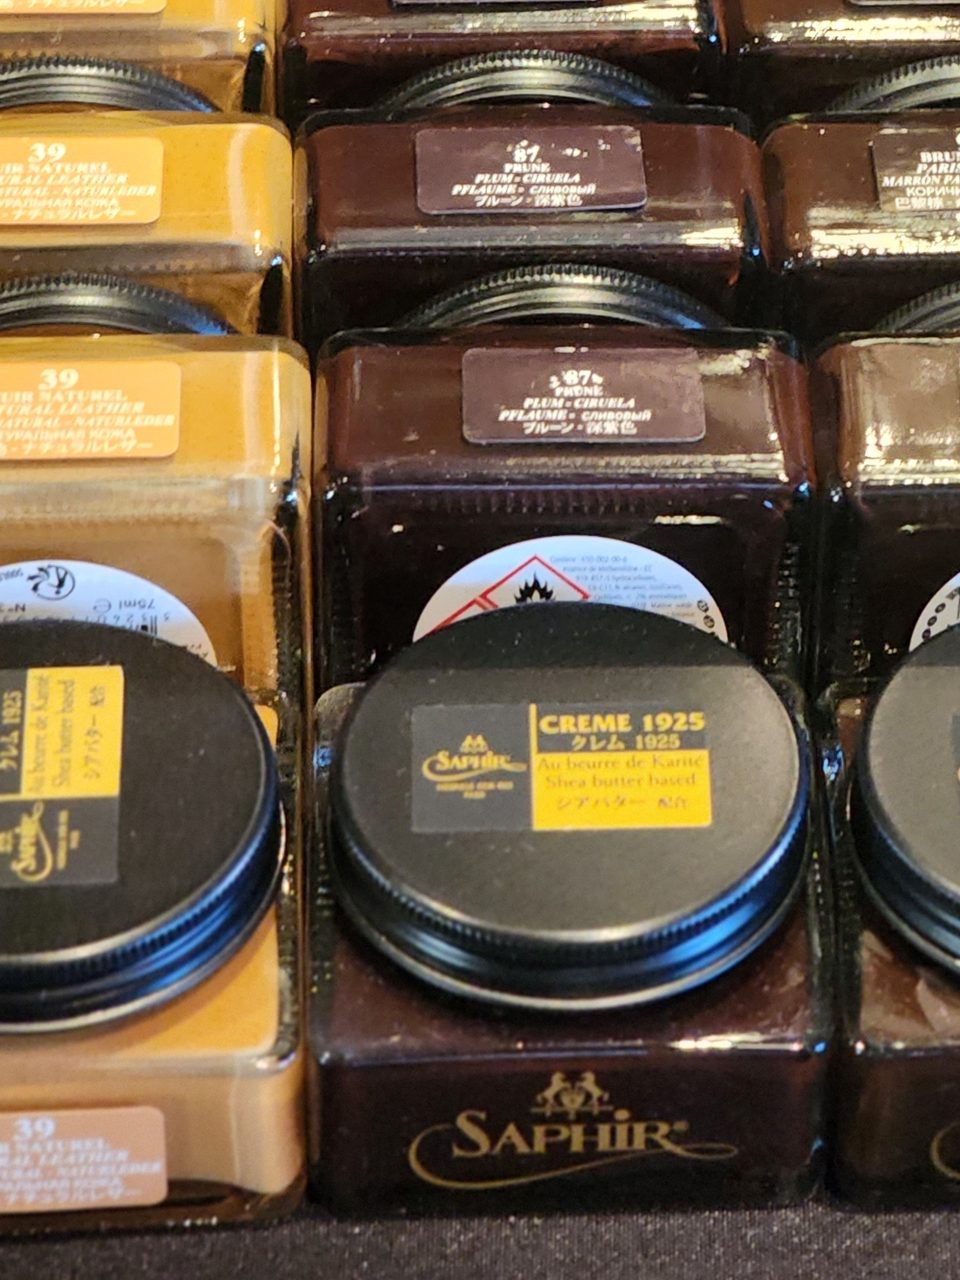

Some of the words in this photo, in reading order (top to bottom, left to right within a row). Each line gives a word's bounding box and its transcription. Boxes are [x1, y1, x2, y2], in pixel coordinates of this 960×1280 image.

[28, 143, 67, 162] 39
[512, 145, 540, 163] 87
[503, 163, 550, 173] PRUNE
[474, 173, 514, 184] PLUM
[522, 173, 581, 183] CIRUELA
[452, 184, 517, 195] PFLAUME
[38, 368, 79, 389] 39
[523, 397, 565, 408] PLUM
[573, 397, 635, 408] CIRUELA
[498, 409, 568, 421] PFLAUME
[118, 598, 155, 610] 75ml
[2, 691, 22, 724] 1925
[539, 714, 632, 734] CREME
[642, 712, 705, 731] 1925
[572, 734, 625, 750] クレム
[635, 734, 680, 750] 1925
[538, 756, 561, 770] Au
[566, 755, 620, 770] beurre
[626, 754, 646, 770] de
[651, 753, 701, 768] Karité
[545, 775, 586, 789] Shea
[593, 774, 643, 787] butter
[648, 773, 696, 787] based
[557, 796, 646, 810] シアバター
[13, 1117, 56, 1140] 39
